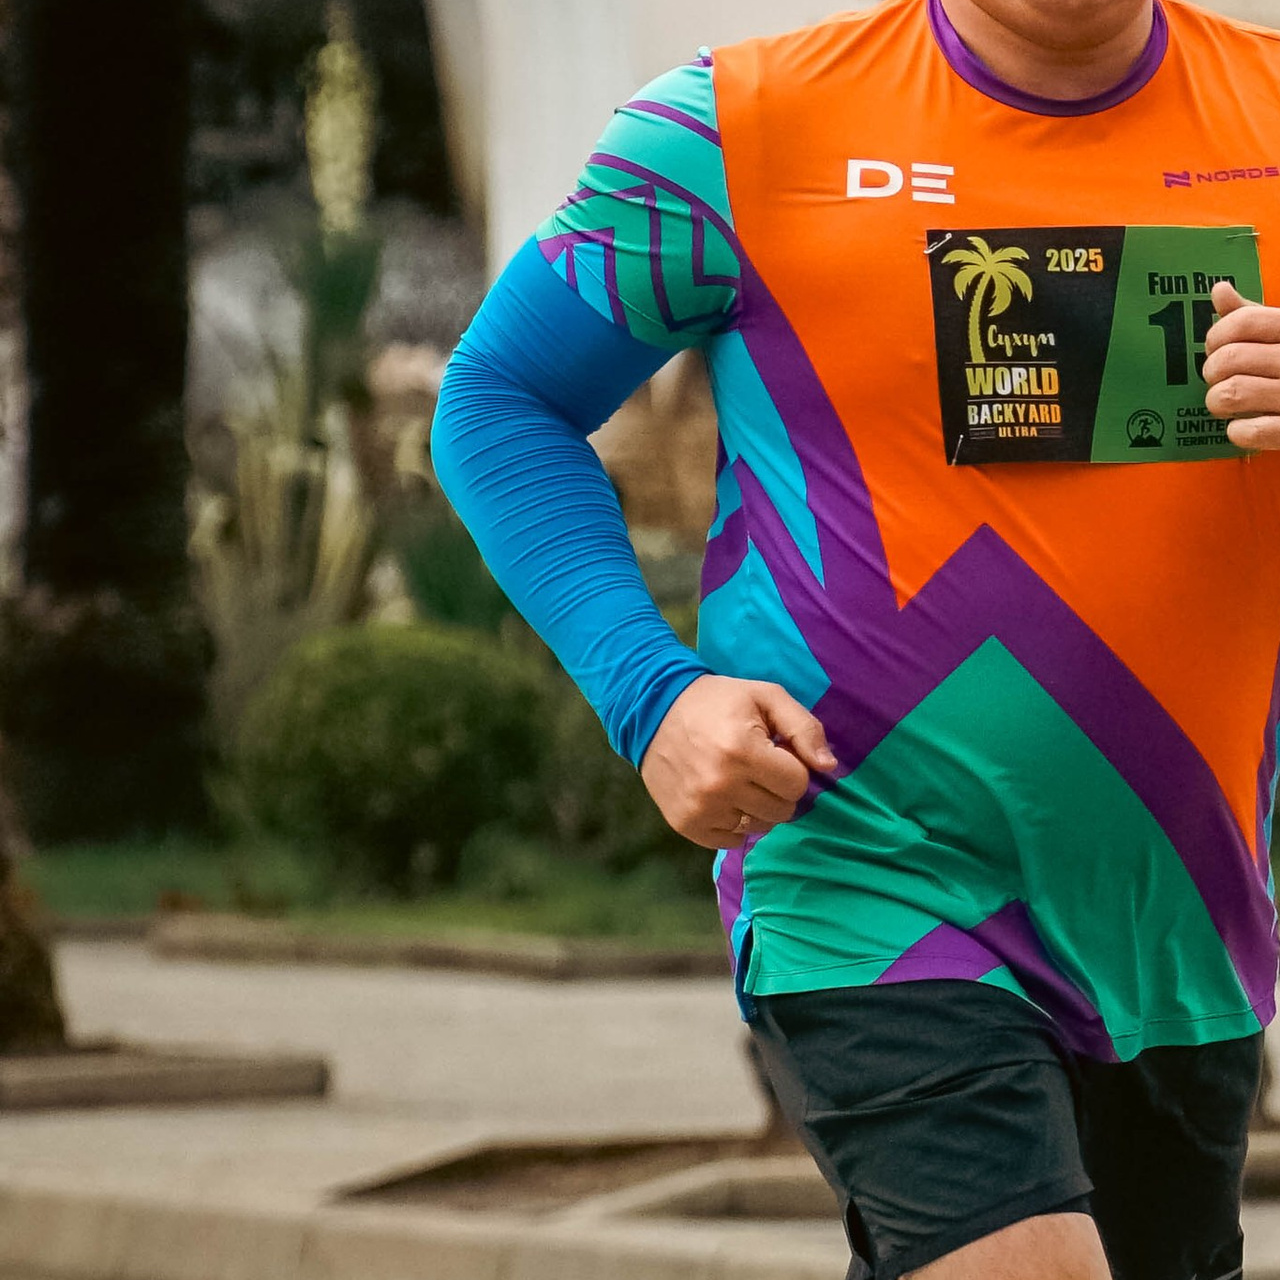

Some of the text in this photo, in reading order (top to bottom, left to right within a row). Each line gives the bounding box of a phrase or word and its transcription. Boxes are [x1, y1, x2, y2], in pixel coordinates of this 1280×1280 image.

[846, 158, 955, 204] DE
[1045, 248, 1104, 272] 2025
[1148, 272, 1189, 295] Fun
[965, 367, 1060, 396] WORLD
[967, 403, 1062, 425] BACKYARD
[1177, 407, 1211, 417] CAUC
[998, 426, 1038, 437] ULTRA
[1176, 419, 1228, 433] UNITE
[1176, 435, 1231, 447] TERRITOR
